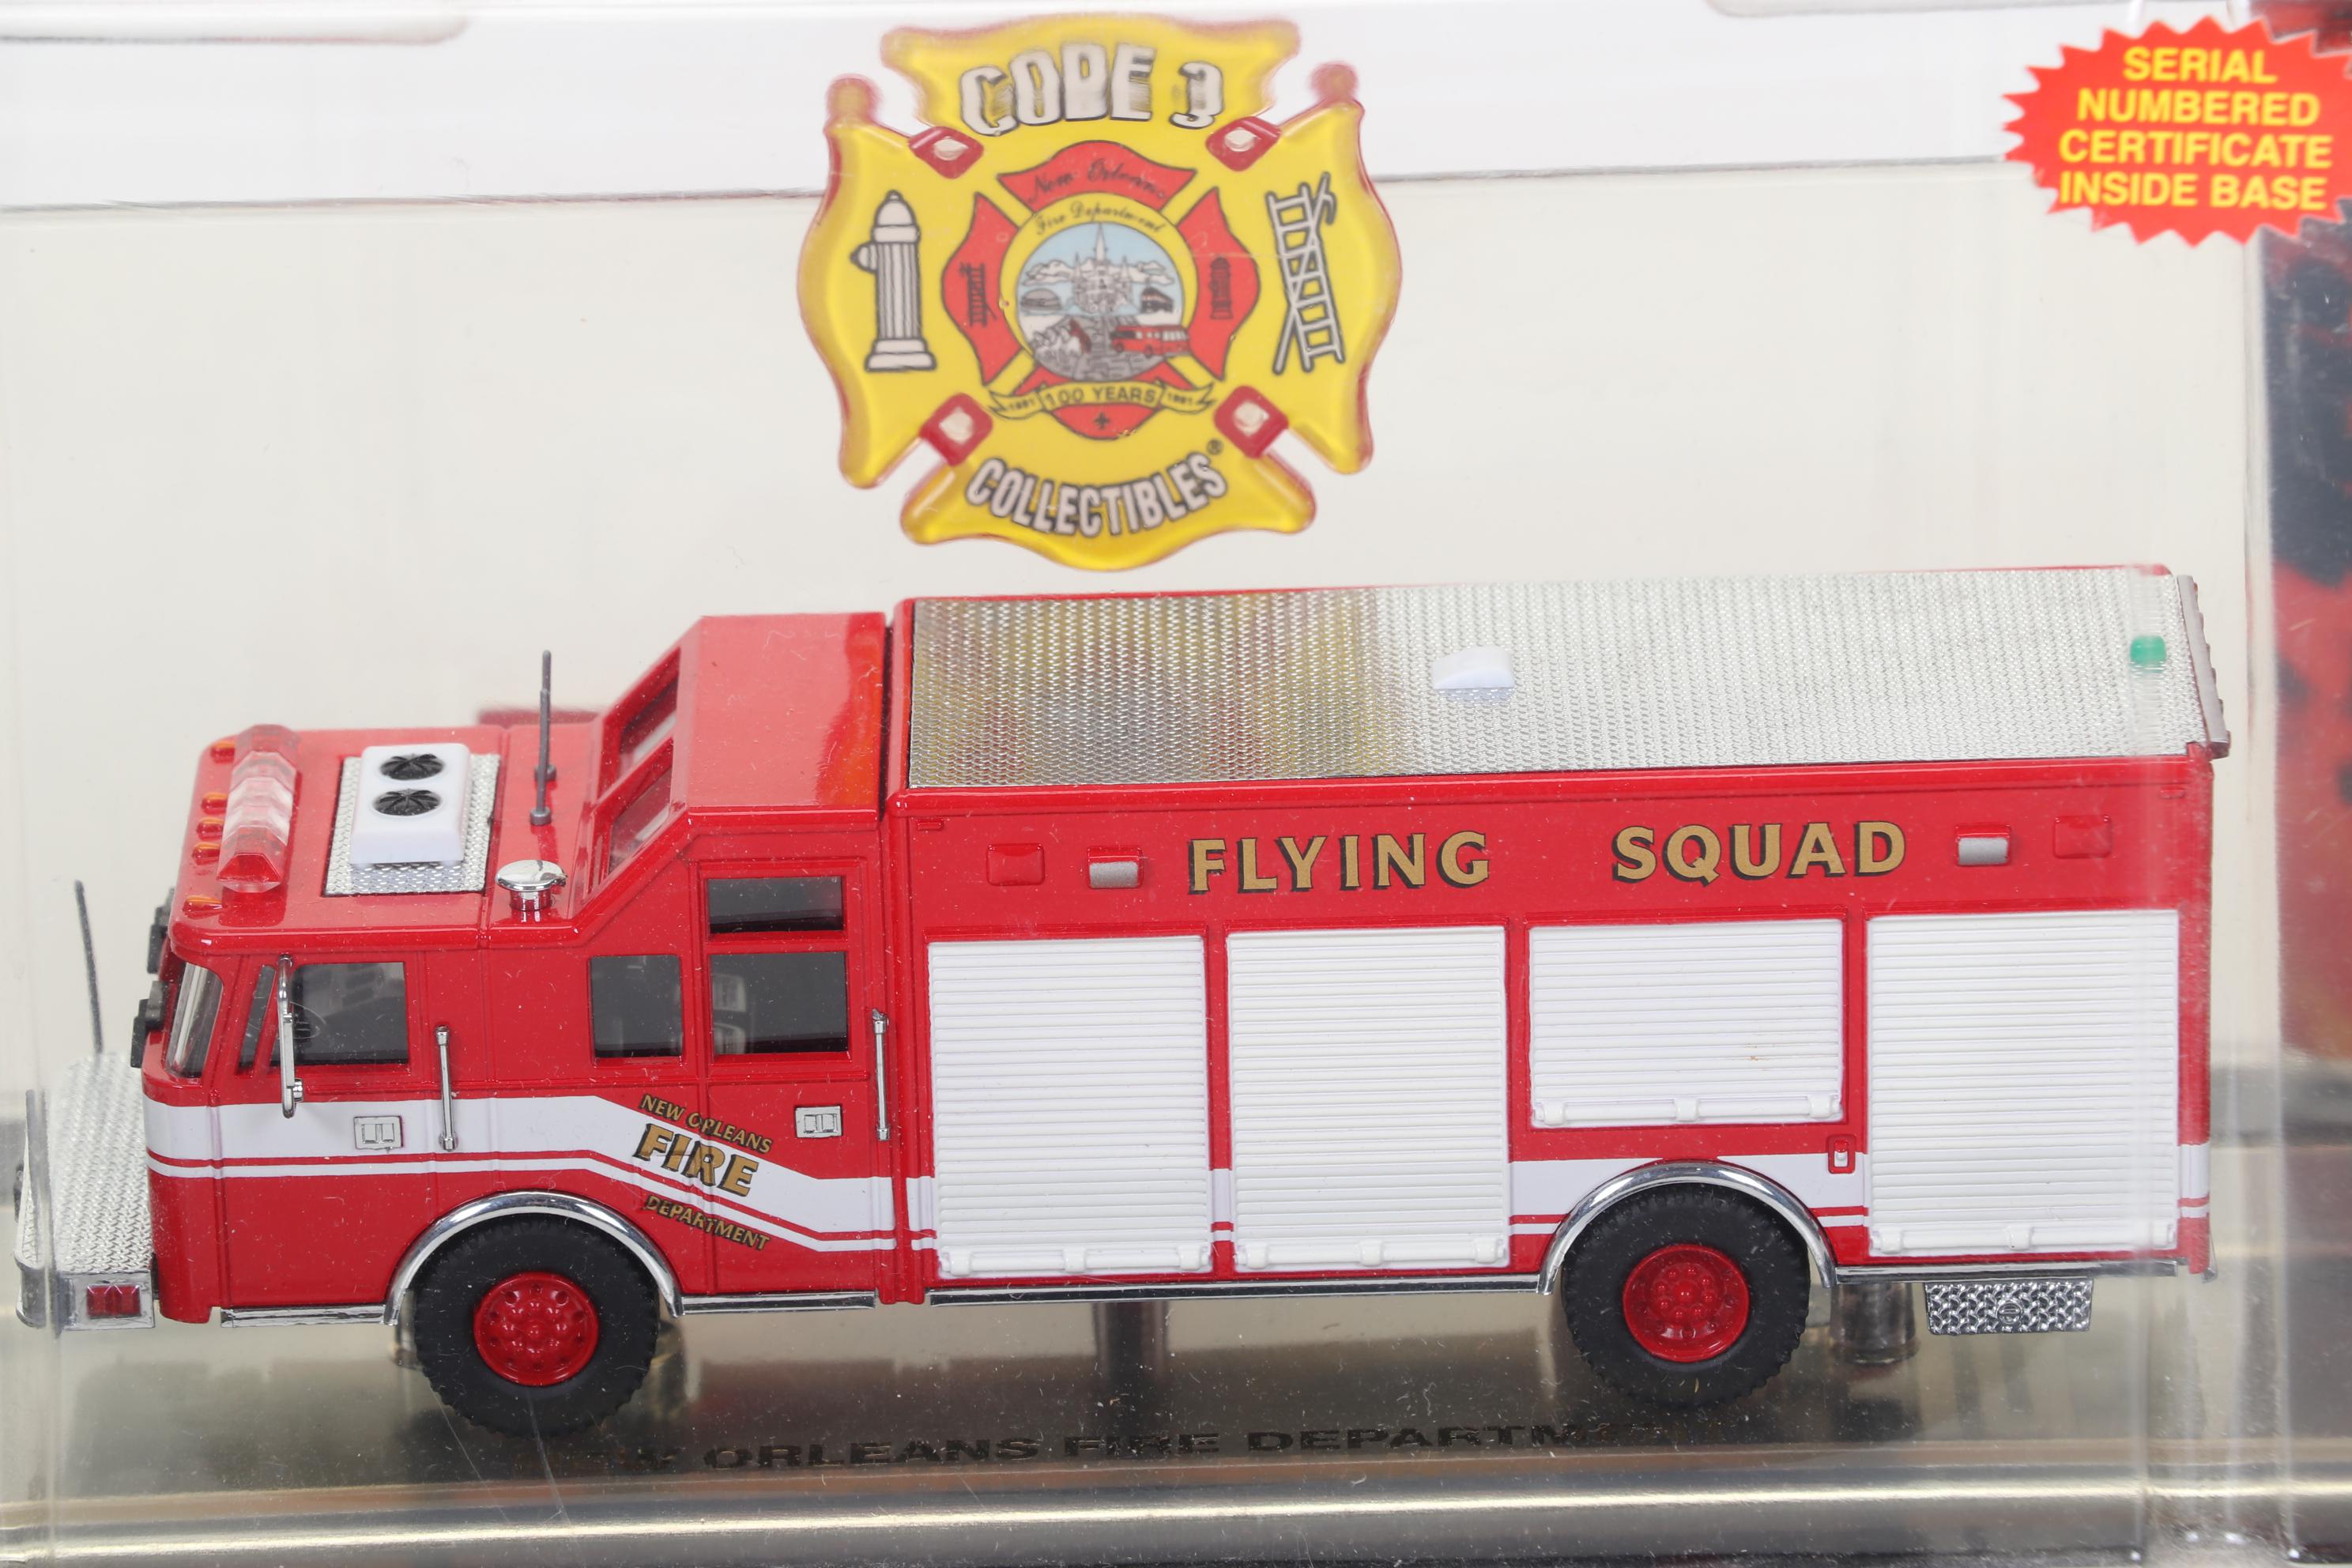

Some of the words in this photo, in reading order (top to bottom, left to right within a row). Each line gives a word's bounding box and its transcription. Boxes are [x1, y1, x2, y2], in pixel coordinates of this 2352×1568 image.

[959, 42, 1156, 137] CODE
[1169, 61, 1224, 130] 3
[2123, 46, 2278, 85] SERIAL
[2076, 88, 2320, 126] NUMBERED
[2059, 129, 2333, 169] CERTIFICATE
[2059, 171, 2198, 206] INSIDE
[2209, 175, 2328, 210] BASE
[1044, 387, 1085, 408] 100
[1091, 386, 1156, 407] YEARS
[965, 450, 1227, 537] COLLECTIBLES
[1186, 831, 1490, 895] FLYING
[1611, 820, 1906, 888] SQUAD
[639, 1094, 685, 1121] NEW
[686, 1112, 774, 1154] ORLEANS
[632, 1123, 759, 1197] FIRE
[643, 1195, 771, 1251] DEPARTMENT
[703, 1435, 1039, 1470] ORLEANS
[1063, 1431, 1221, 1458] FIRE
[1247, 1423, 1652, 1451] DEPARTM
